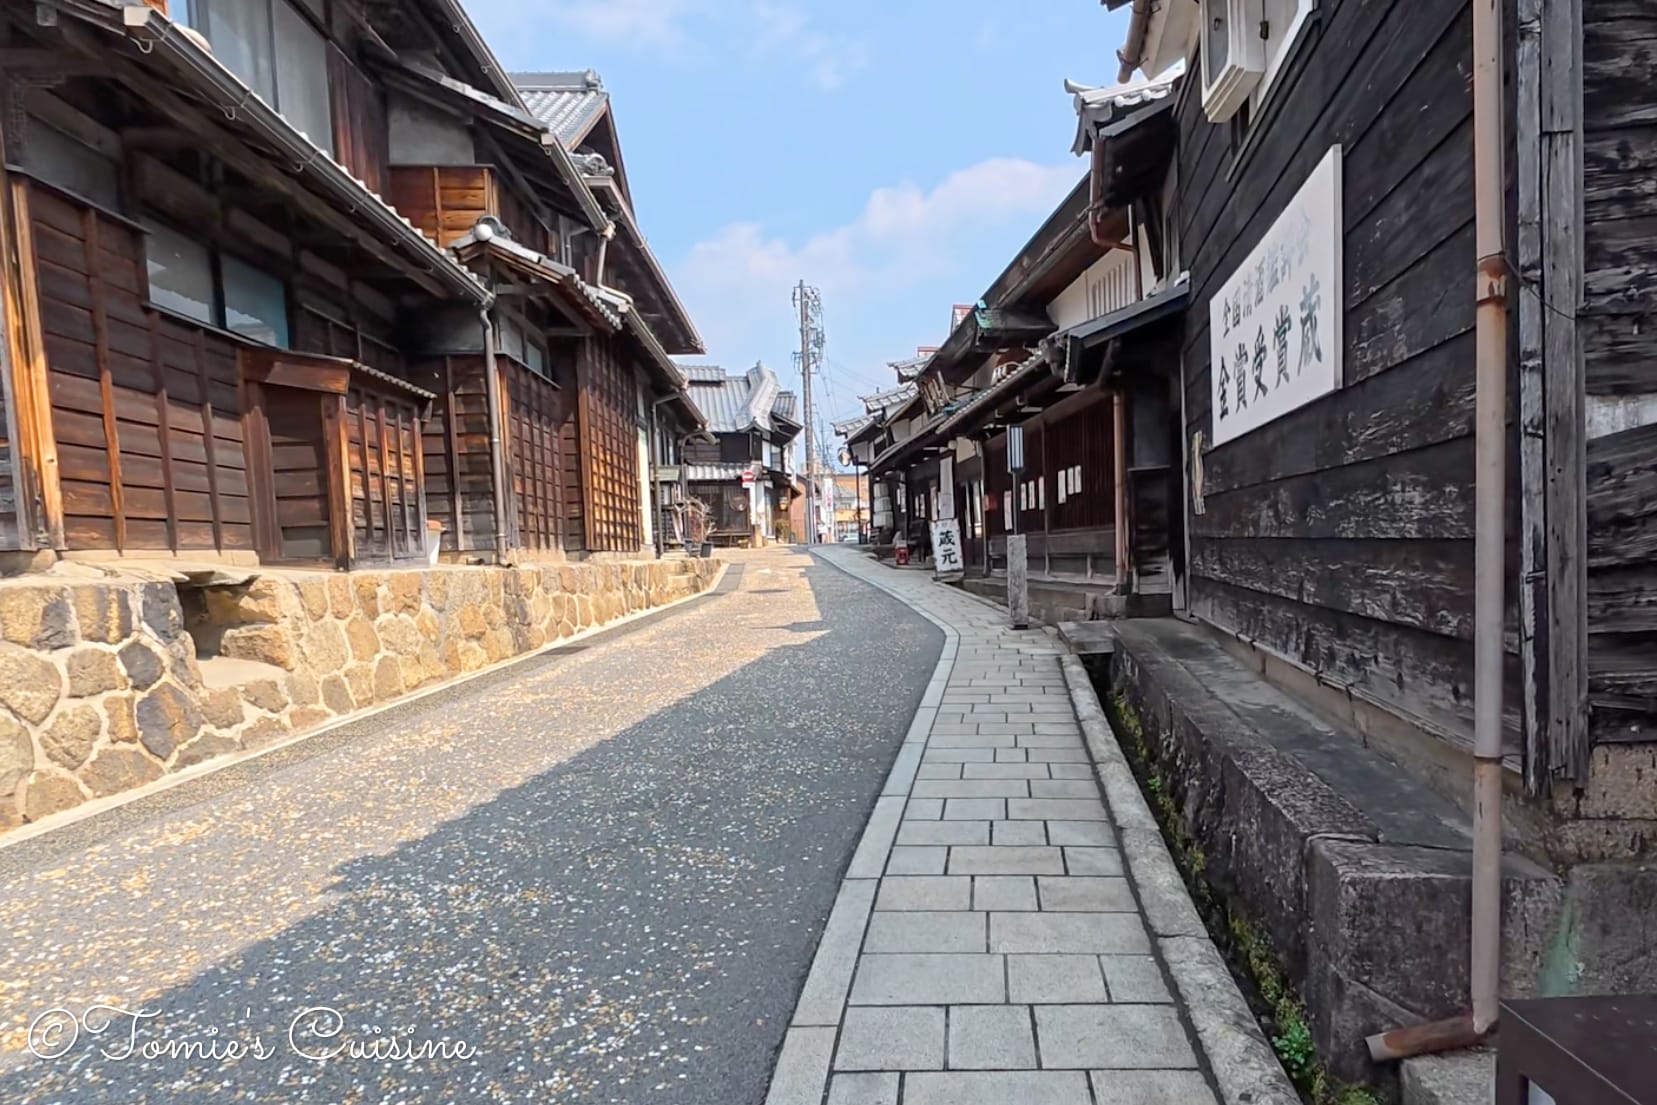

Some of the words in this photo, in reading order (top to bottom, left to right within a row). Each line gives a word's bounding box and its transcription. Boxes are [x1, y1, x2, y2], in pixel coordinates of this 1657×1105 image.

[1216, 271, 1323, 420] 金賞受賞蔵
[938, 530, 958, 565] 蔵元
